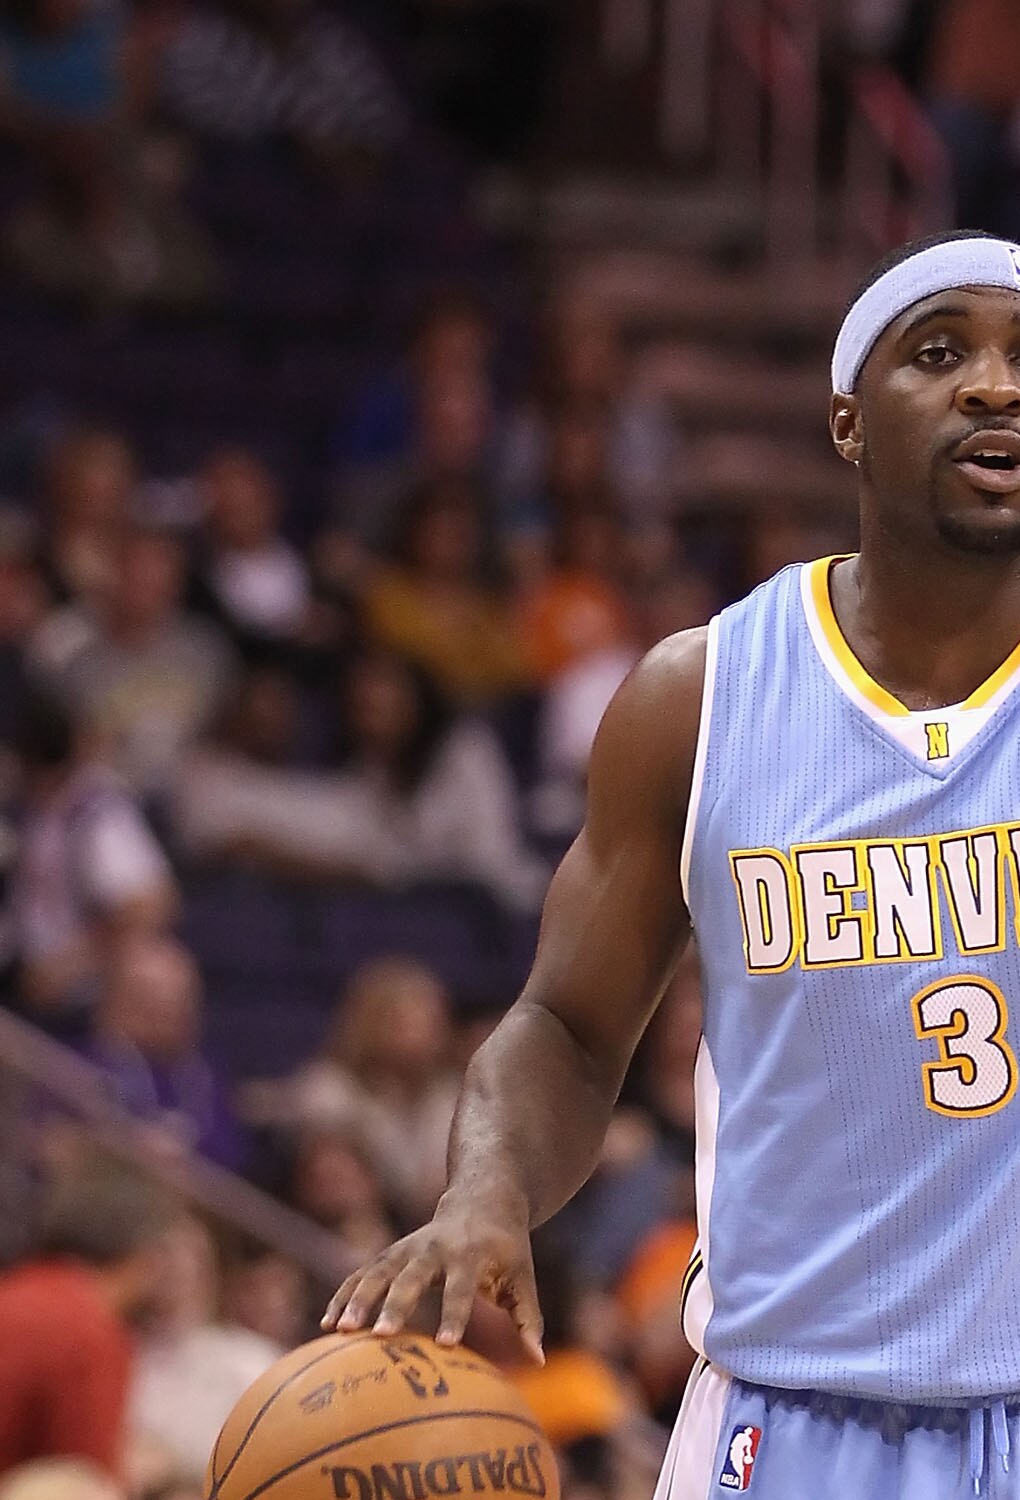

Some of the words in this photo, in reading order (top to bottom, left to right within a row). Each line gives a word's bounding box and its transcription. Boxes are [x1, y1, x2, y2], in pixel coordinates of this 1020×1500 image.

[924, 722, 949, 760] N
[911, 974, 1018, 1118] 3
[720, 1473, 740, 1487] NBA
